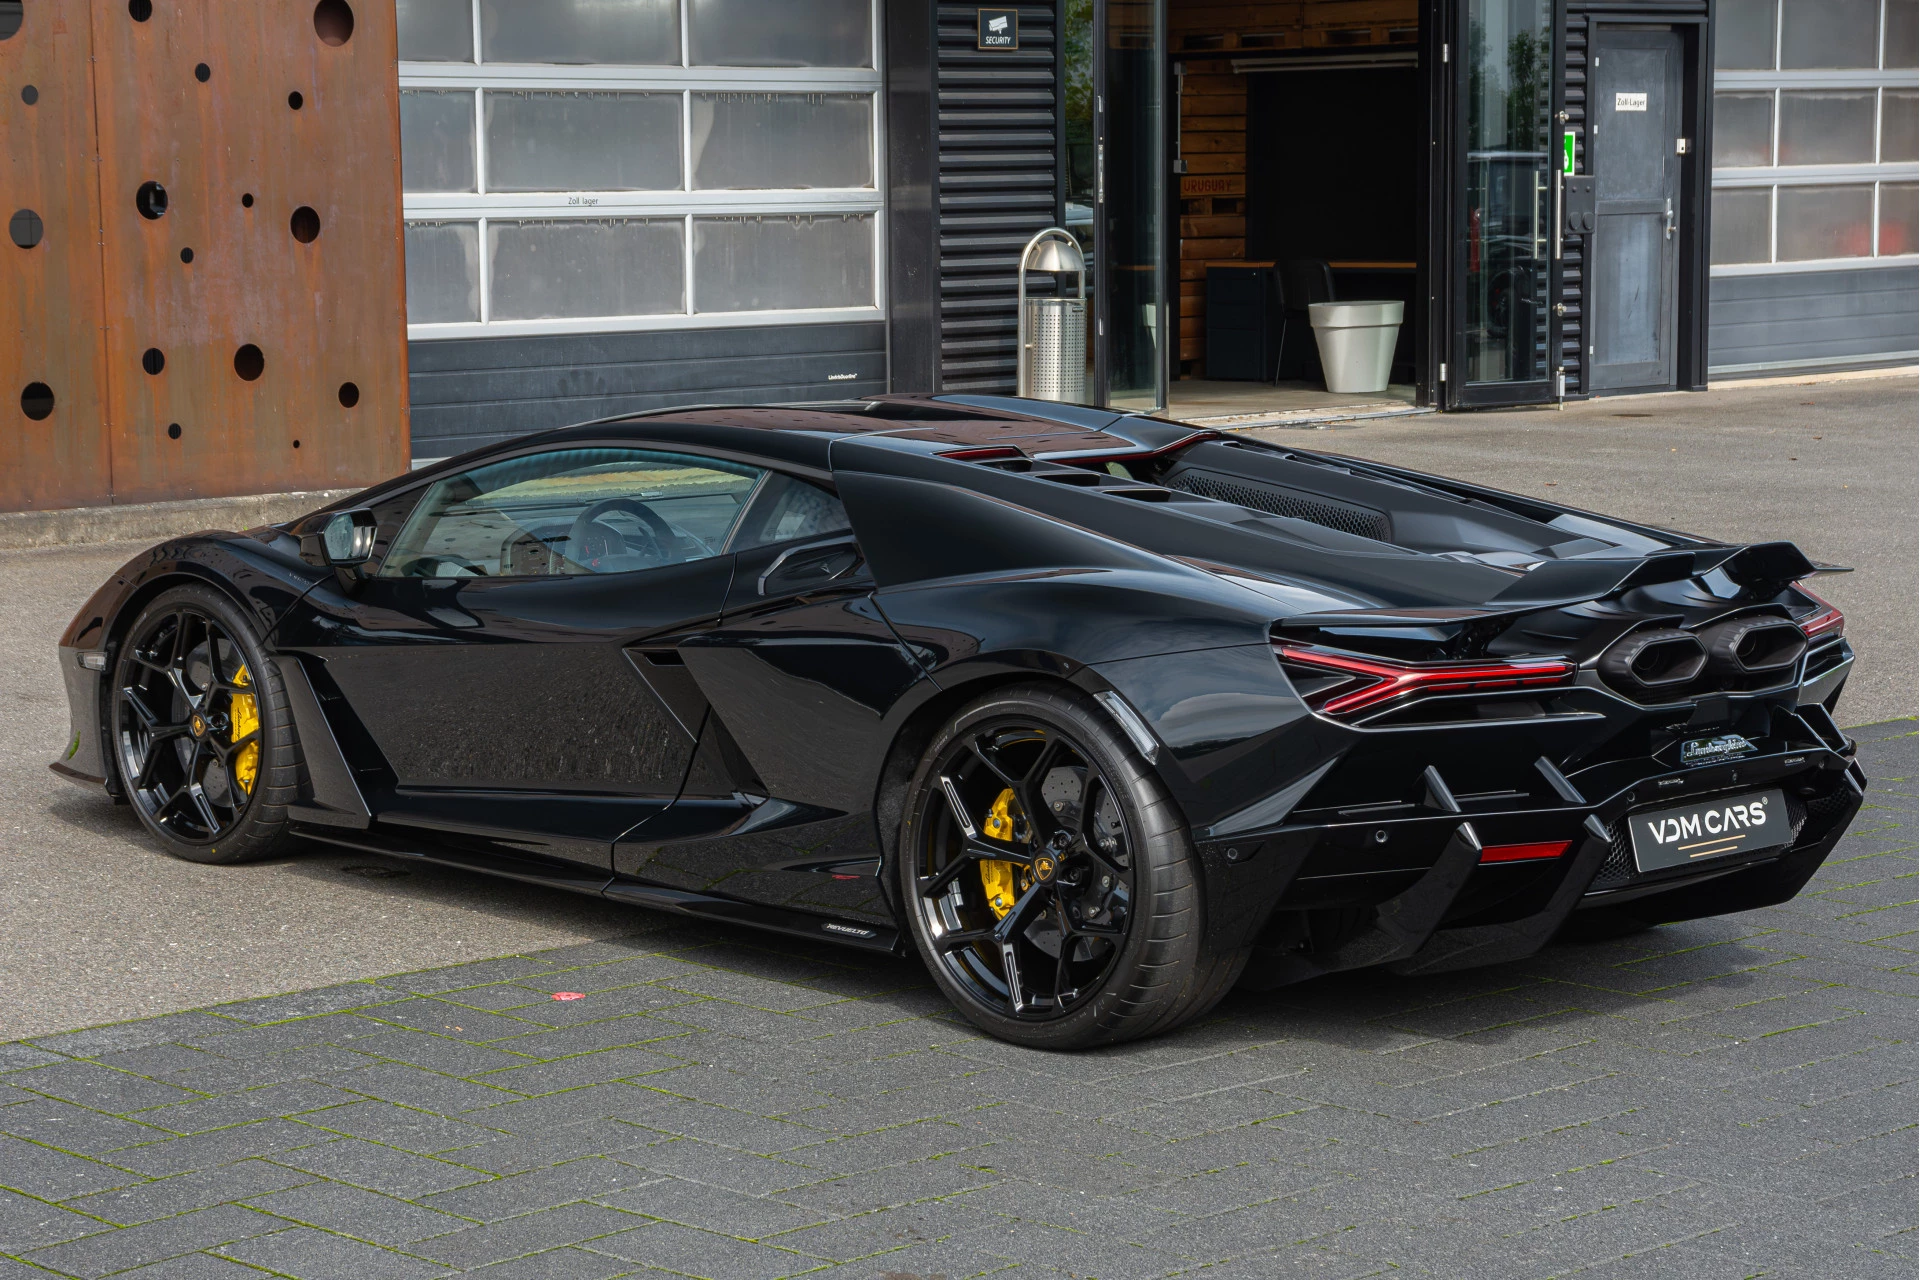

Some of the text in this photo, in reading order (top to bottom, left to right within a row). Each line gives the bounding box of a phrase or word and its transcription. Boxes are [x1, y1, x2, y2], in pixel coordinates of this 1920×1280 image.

[985, 36, 1011, 44] SECURITY
[1183, 179, 1231, 192] URUGUAY
[582, 197, 598, 206] lager
[1647, 813, 1702, 844] VDM
